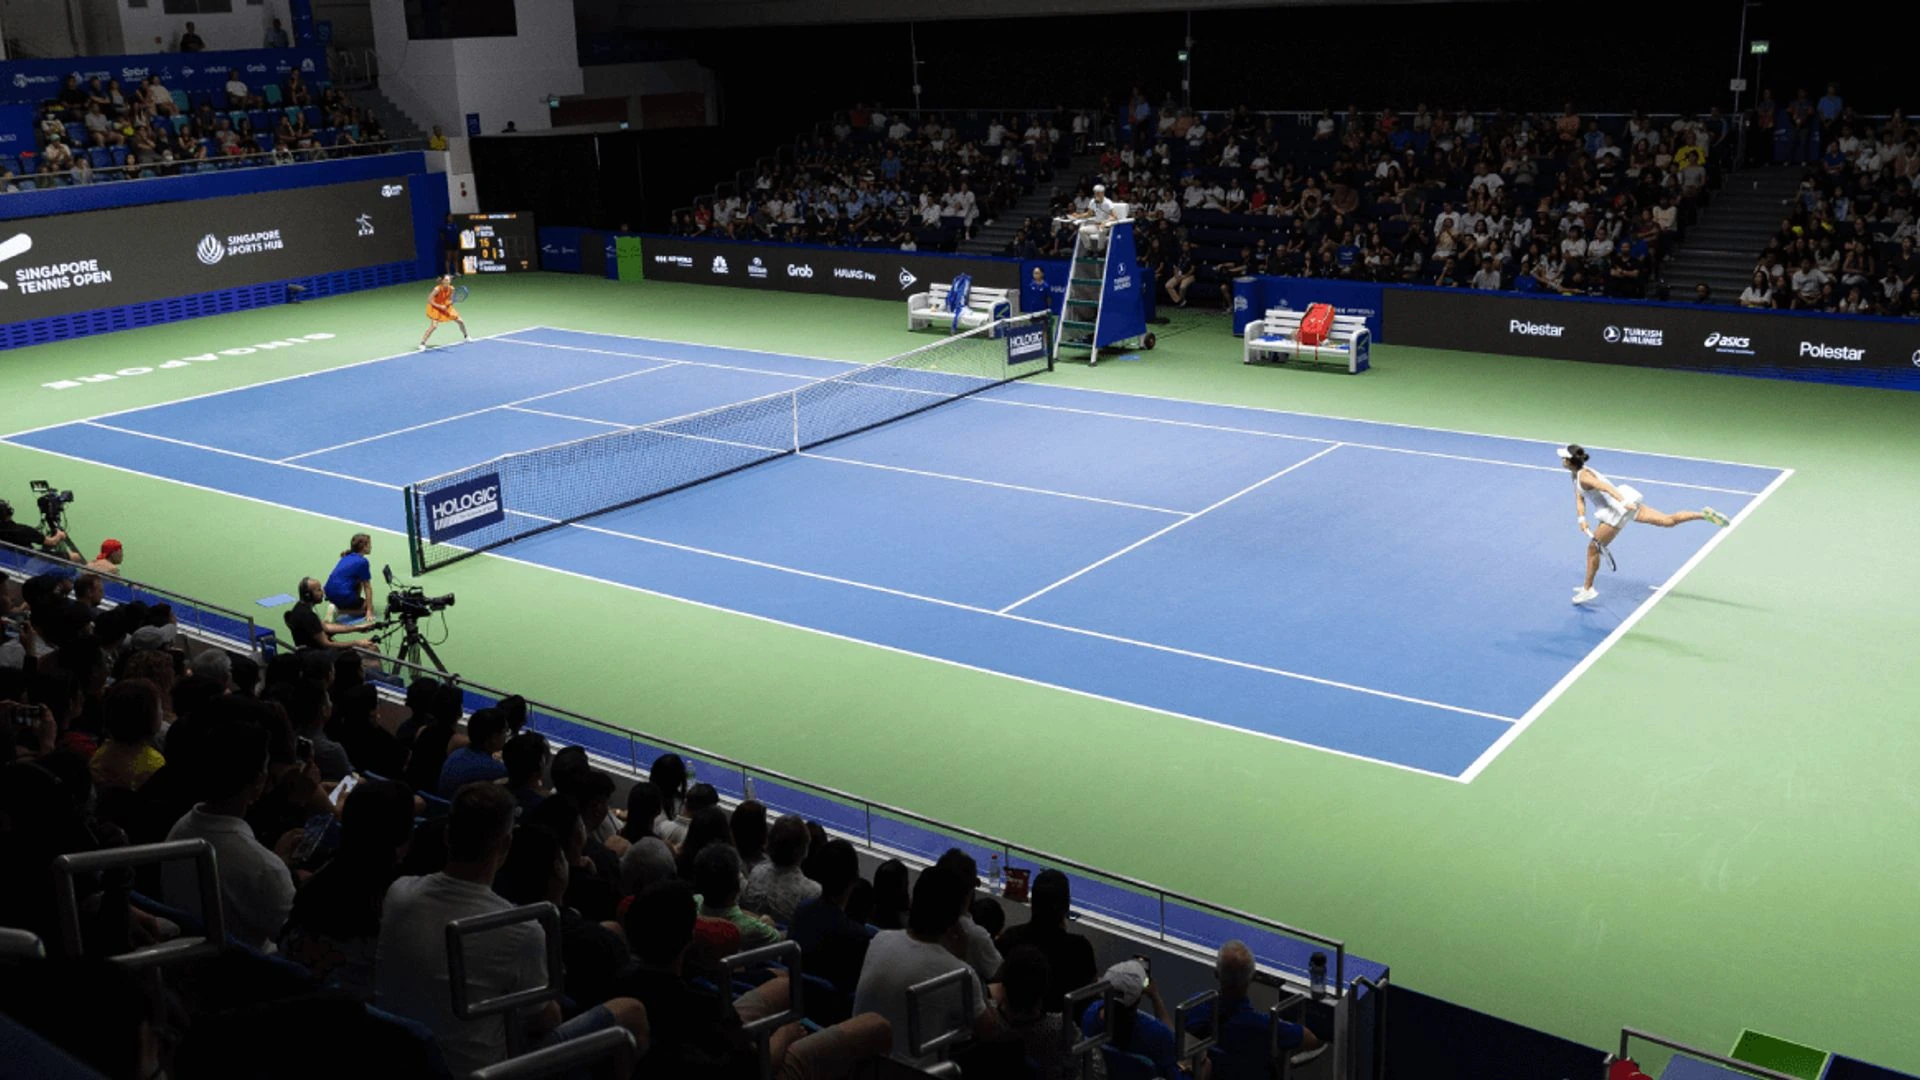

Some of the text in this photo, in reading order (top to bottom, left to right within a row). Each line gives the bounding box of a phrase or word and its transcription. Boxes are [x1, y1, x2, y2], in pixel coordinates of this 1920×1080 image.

[228, 230, 280, 245] SINGAPORE
[480, 238, 503, 247] 15 1
[227, 239, 284, 256] SPORTS HUB
[482, 249, 505, 258] 0 3
[16, 259, 99, 282] SINGAPORE
[787, 264, 814, 278] Grab
[834, 268, 864, 279] HAVAS
[18, 270, 112, 295] TENNIS OPEN
[1510, 319, 1565, 337] Polestar
[1623, 327, 1663, 338] TURKISH
[1622, 336, 1663, 346] AIRLINES
[1719, 335, 1750, 348] asics
[1800, 341, 1865, 361] Polestar
[432, 486, 497, 519] HOLOGIC
